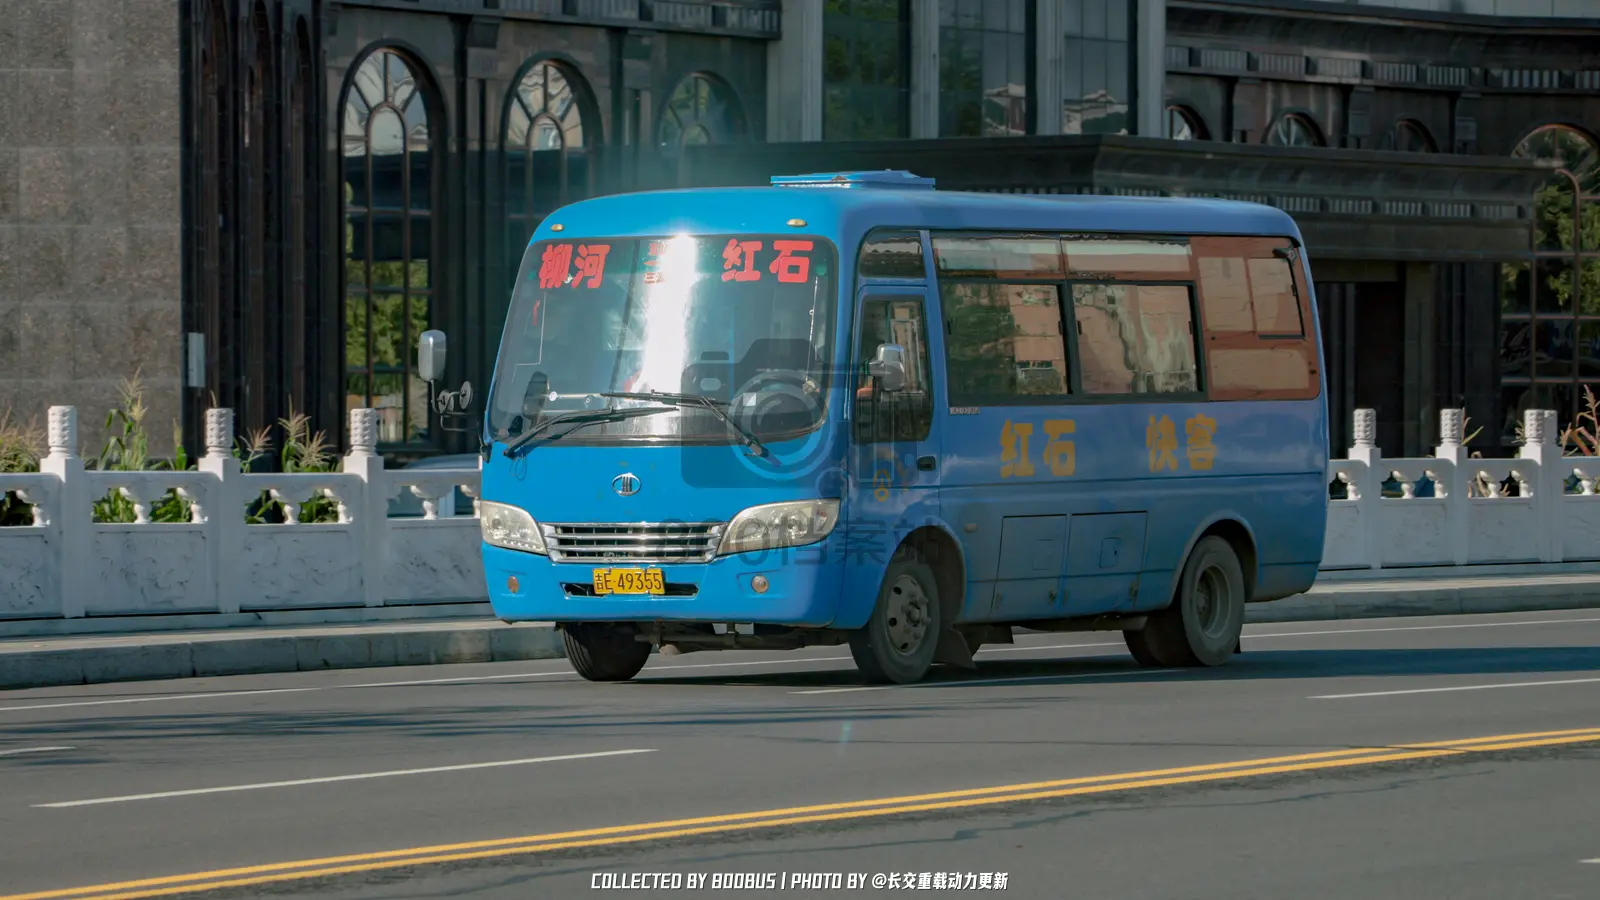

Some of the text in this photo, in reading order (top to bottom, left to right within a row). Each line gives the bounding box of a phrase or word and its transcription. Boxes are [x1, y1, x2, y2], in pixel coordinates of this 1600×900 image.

[539, 243, 610, 288] 柳河
[721, 238, 813, 283] 红石
[1000, 413, 1217, 479] 红石 快客
